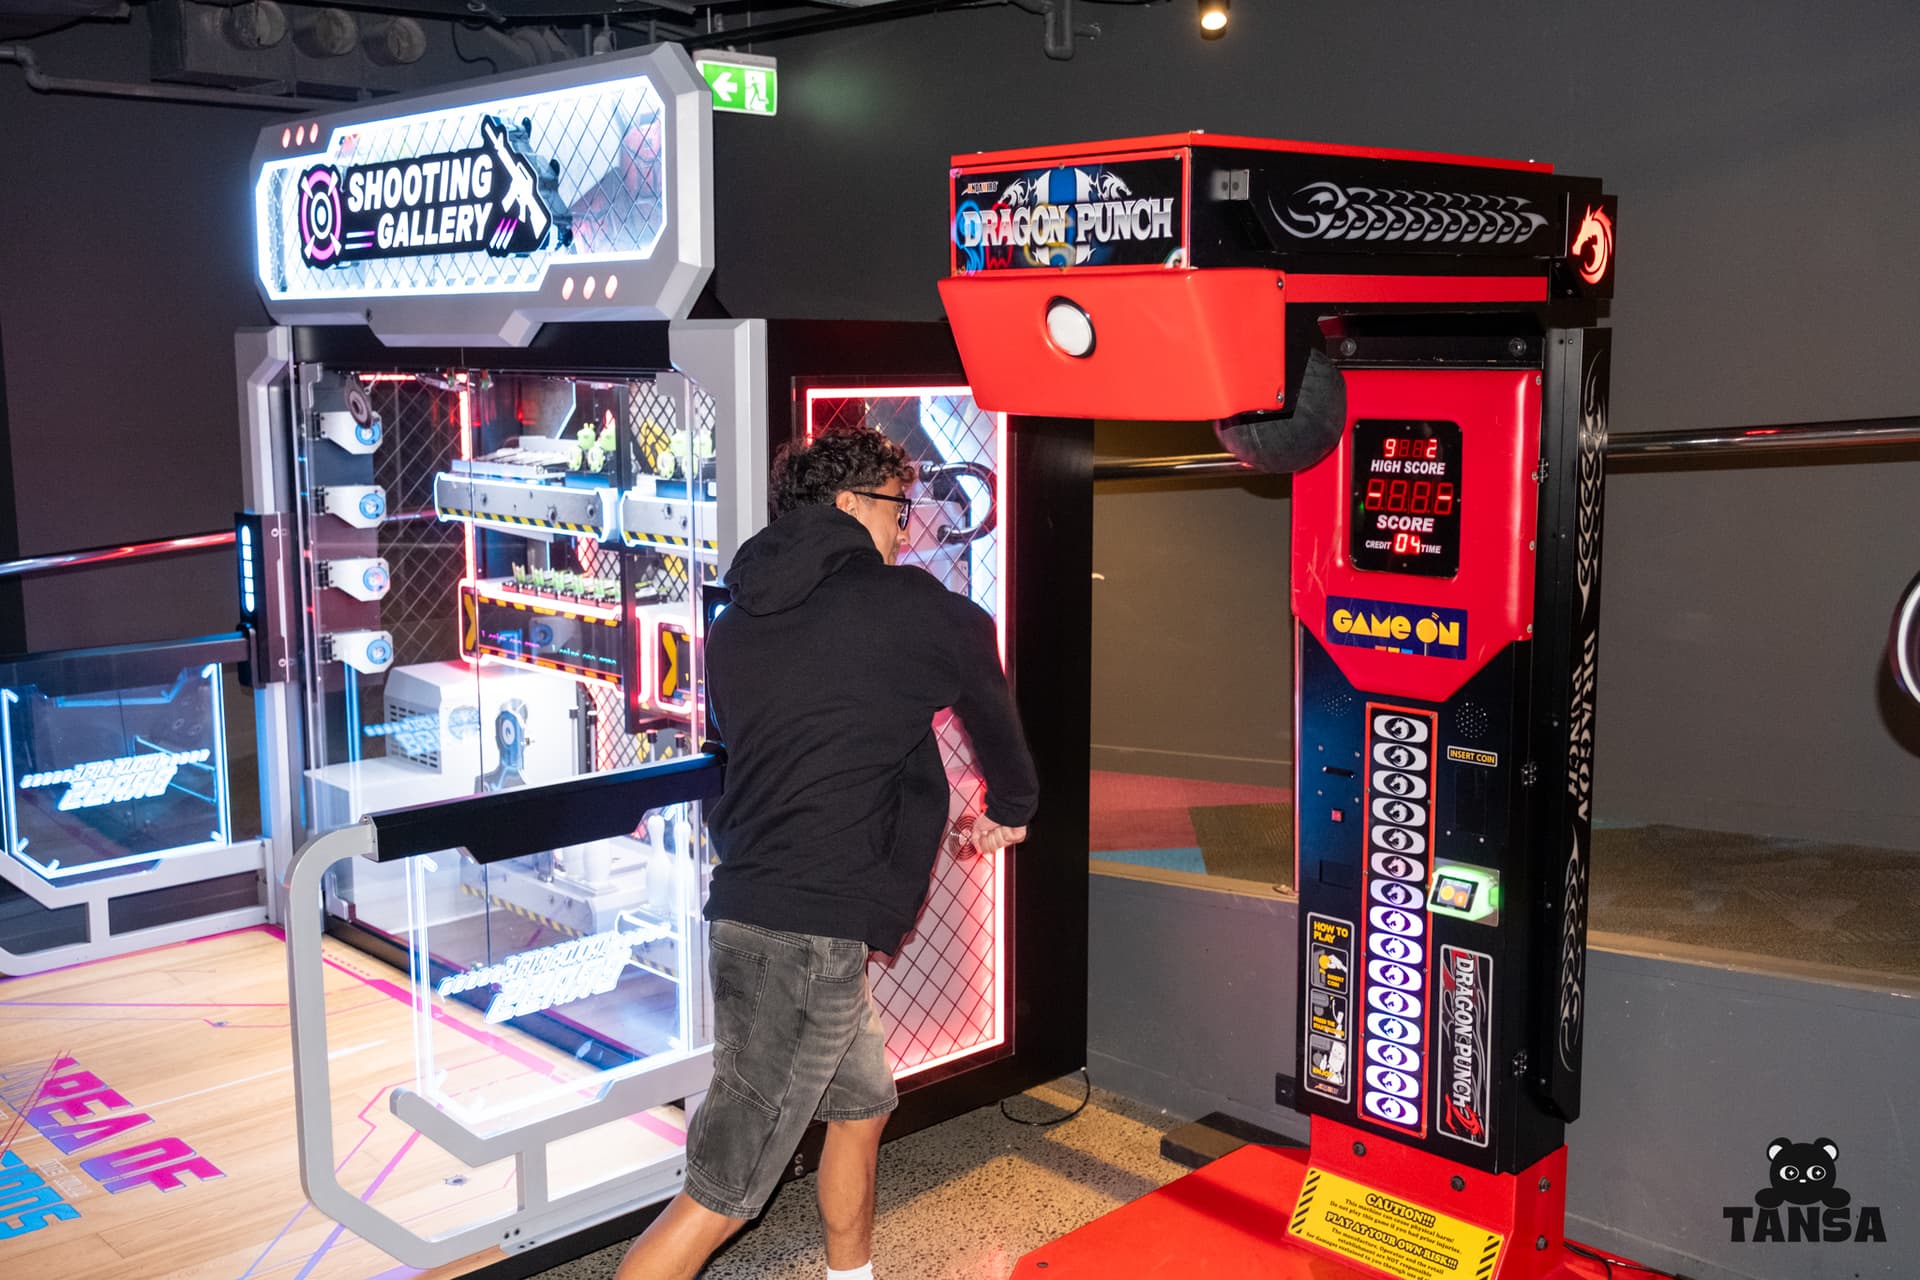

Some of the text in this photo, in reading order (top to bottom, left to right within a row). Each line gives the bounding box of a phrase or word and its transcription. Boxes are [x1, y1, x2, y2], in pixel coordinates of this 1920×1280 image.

[347, 154, 493, 213] SHOOTING
[377, 202, 494, 249] GALLERY
[962, 197, 1175, 248] DRAGON PUNCH
[1370, 459, 1446, 475] HIGH SCORE
[1365, 533, 1442, 554] CREDIT 04 TIME
[1376, 515, 1434, 532] SCORE
[1568, 664, 1583, 797] PUNCH
[1578, 629, 1596, 822] DRAGON
[1450, 749, 1496, 764] INSERT COIN
[1313, 921, 1349, 938] HOW TO
[1313, 930, 1335, 943] PLAY
[1454, 956, 1474, 1039] DRAGON
[1453, 1042, 1472, 1107] PUNCH
[79, 1136, 227, 1194] OF
[1365, 1193, 1436, 1228] CAUTION!!!
[1325, 1211, 1458, 1270] PLAY AT YOUR OWN RISK!!!
[1386, 1256, 1399, 1265] NOT
